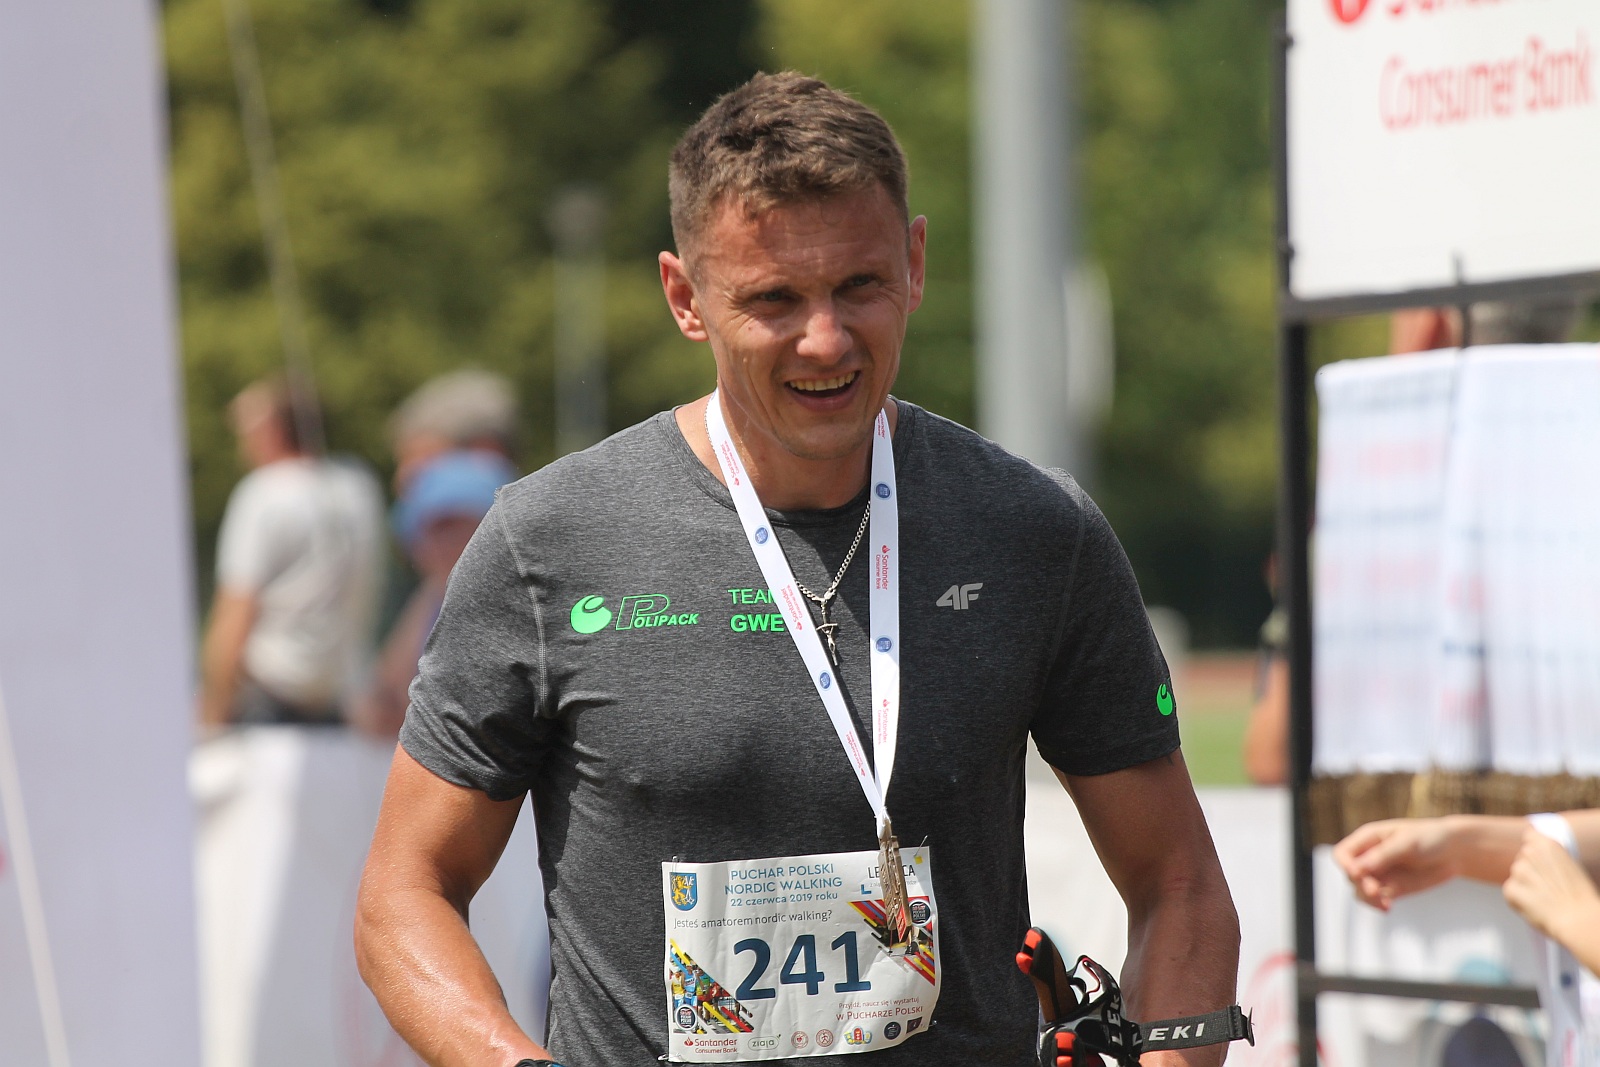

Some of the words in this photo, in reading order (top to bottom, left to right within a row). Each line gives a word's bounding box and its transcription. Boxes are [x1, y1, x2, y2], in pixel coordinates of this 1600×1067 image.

[935, 582, 983, 610] 4F
[615, 593, 699, 631] POLIPACK
[730, 867, 785, 881] PUCHAR
[788, 863, 834, 877] POLSKI
[867, 864, 916, 879] LECA
[724, 881, 776, 895] NORDIC
[780, 876, 843, 891] WALKING
[730, 898, 743, 907] 22
[745, 895, 787, 906] czerwca
[789, 893, 813, 903] 2019
[815, 891, 838, 901] roku
[673, 918, 699, 929] Jesteś
[701, 916, 753, 928] amatorem
[755, 912, 787, 924] nordic
[788, 909, 833, 923] walking?
[733, 930, 872, 1001] 241
[847, 1009, 893, 1020] PUCHARZE
[895, 1005, 924, 1016] POLSKI
[694, 1038, 738, 1047] Santander
[752, 1039, 775, 1048] ziaja
